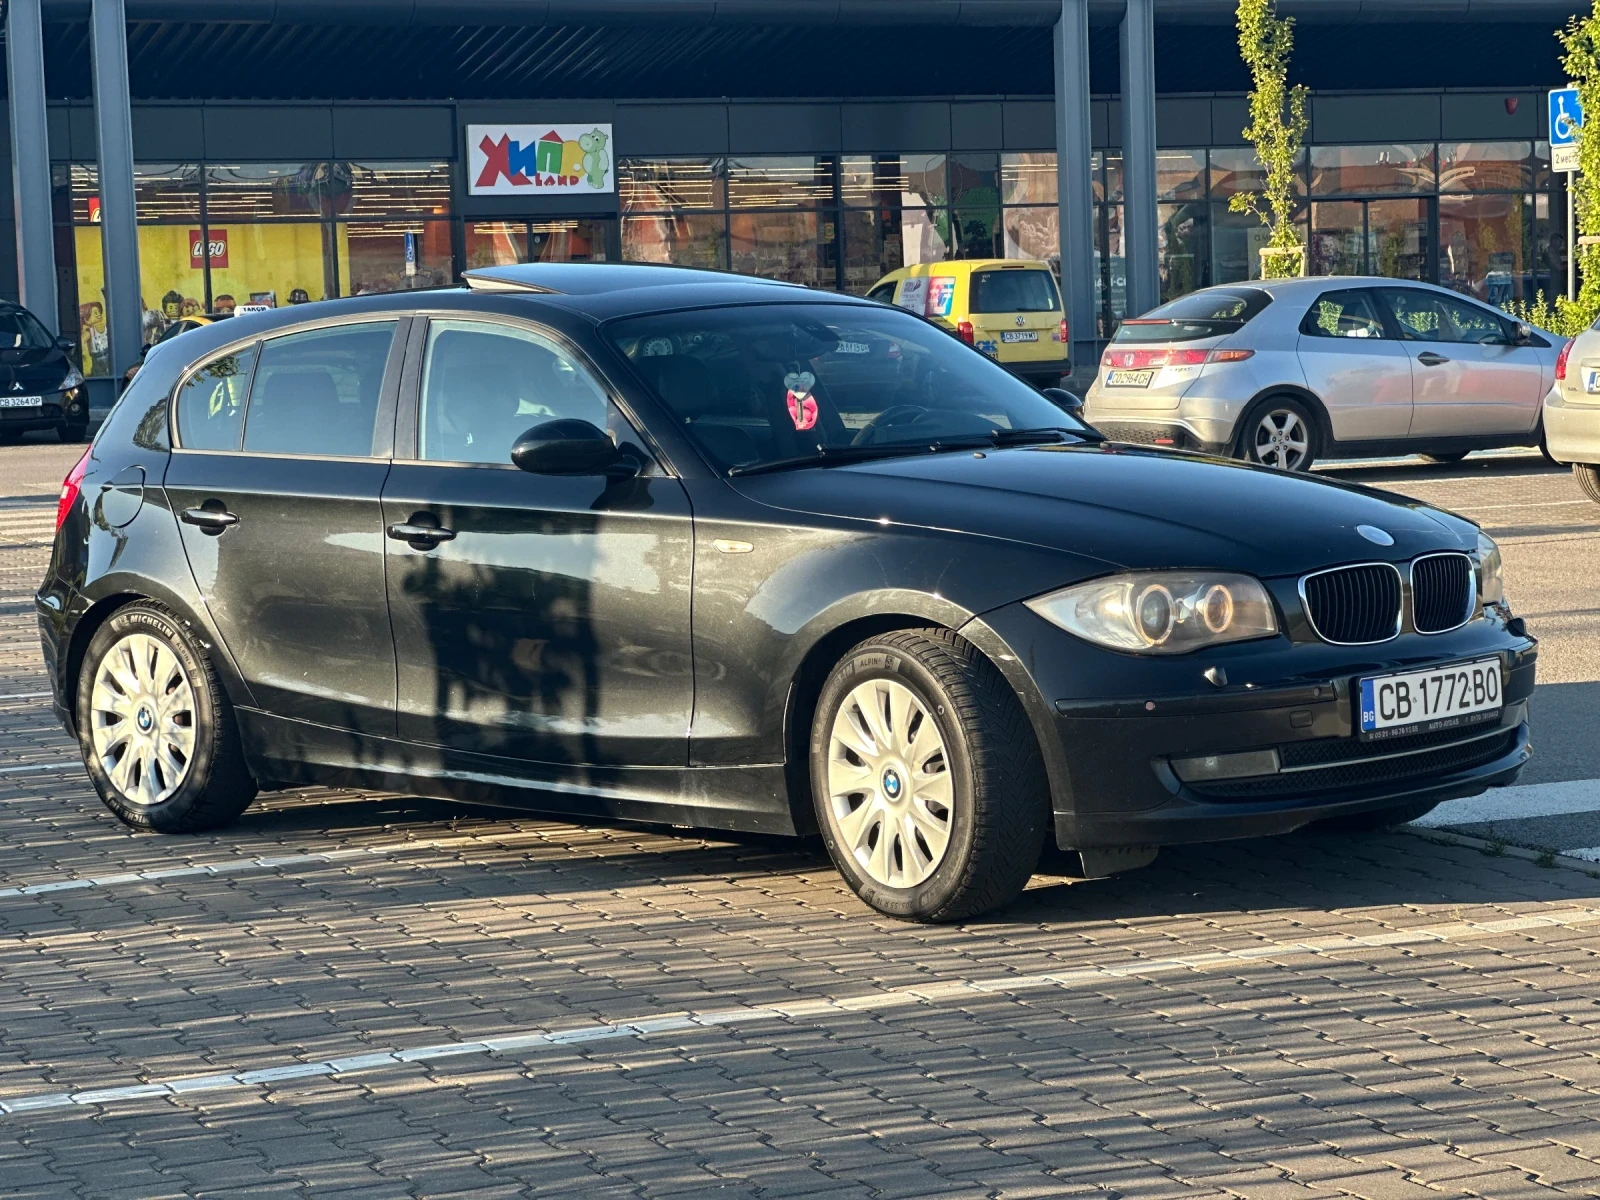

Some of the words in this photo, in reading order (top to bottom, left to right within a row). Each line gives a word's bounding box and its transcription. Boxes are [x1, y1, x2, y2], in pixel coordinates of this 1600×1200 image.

[1556, 154, 1560, 163] 2
[535, 173, 579, 186] LAND
[193, 241, 225, 256] LGO
[130, 615, 173, 638] MICHELIN
[1379, 681, 1412, 721] CB
[1419, 672, 1471, 715] 1772
[1472, 666, 1498, 707] BO
[1363, 710, 1374, 722] BG
